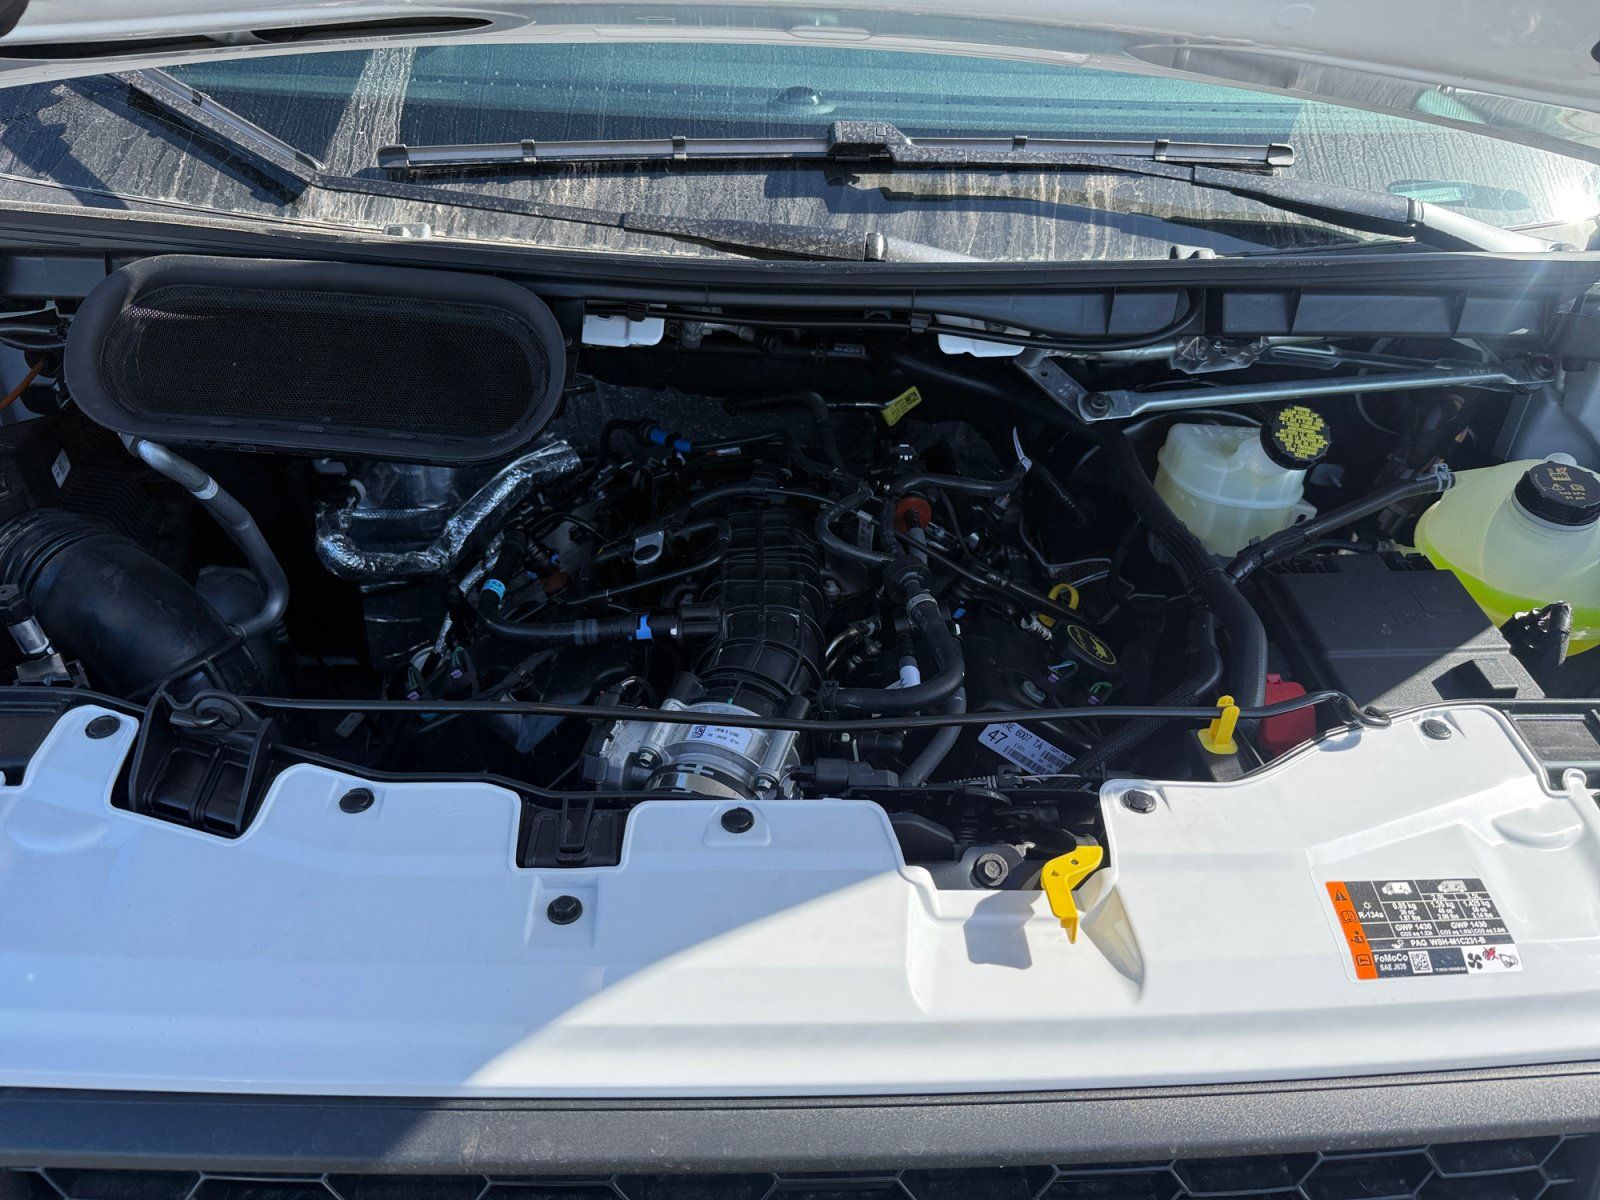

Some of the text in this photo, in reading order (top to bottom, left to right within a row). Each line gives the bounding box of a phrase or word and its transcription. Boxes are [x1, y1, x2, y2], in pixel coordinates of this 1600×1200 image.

[988, 729, 1008, 745] 47
[1015, 730, 1033, 741] 6007
[1032, 739, 1043, 750] TA
[1407, 902, 1418, 910] kg
[1444, 900, 1456, 909] kg
[1480, 900, 1491, 908] kg
[1358, 911, 1384, 919] R-134a
[1395, 922, 1433, 932] GWP 1430
[1450, 921, 1468, 929] GWP
[1428, 937, 1486, 946] WSH-M1C231-B
[1374, 954, 1408, 963] FoMoCo
